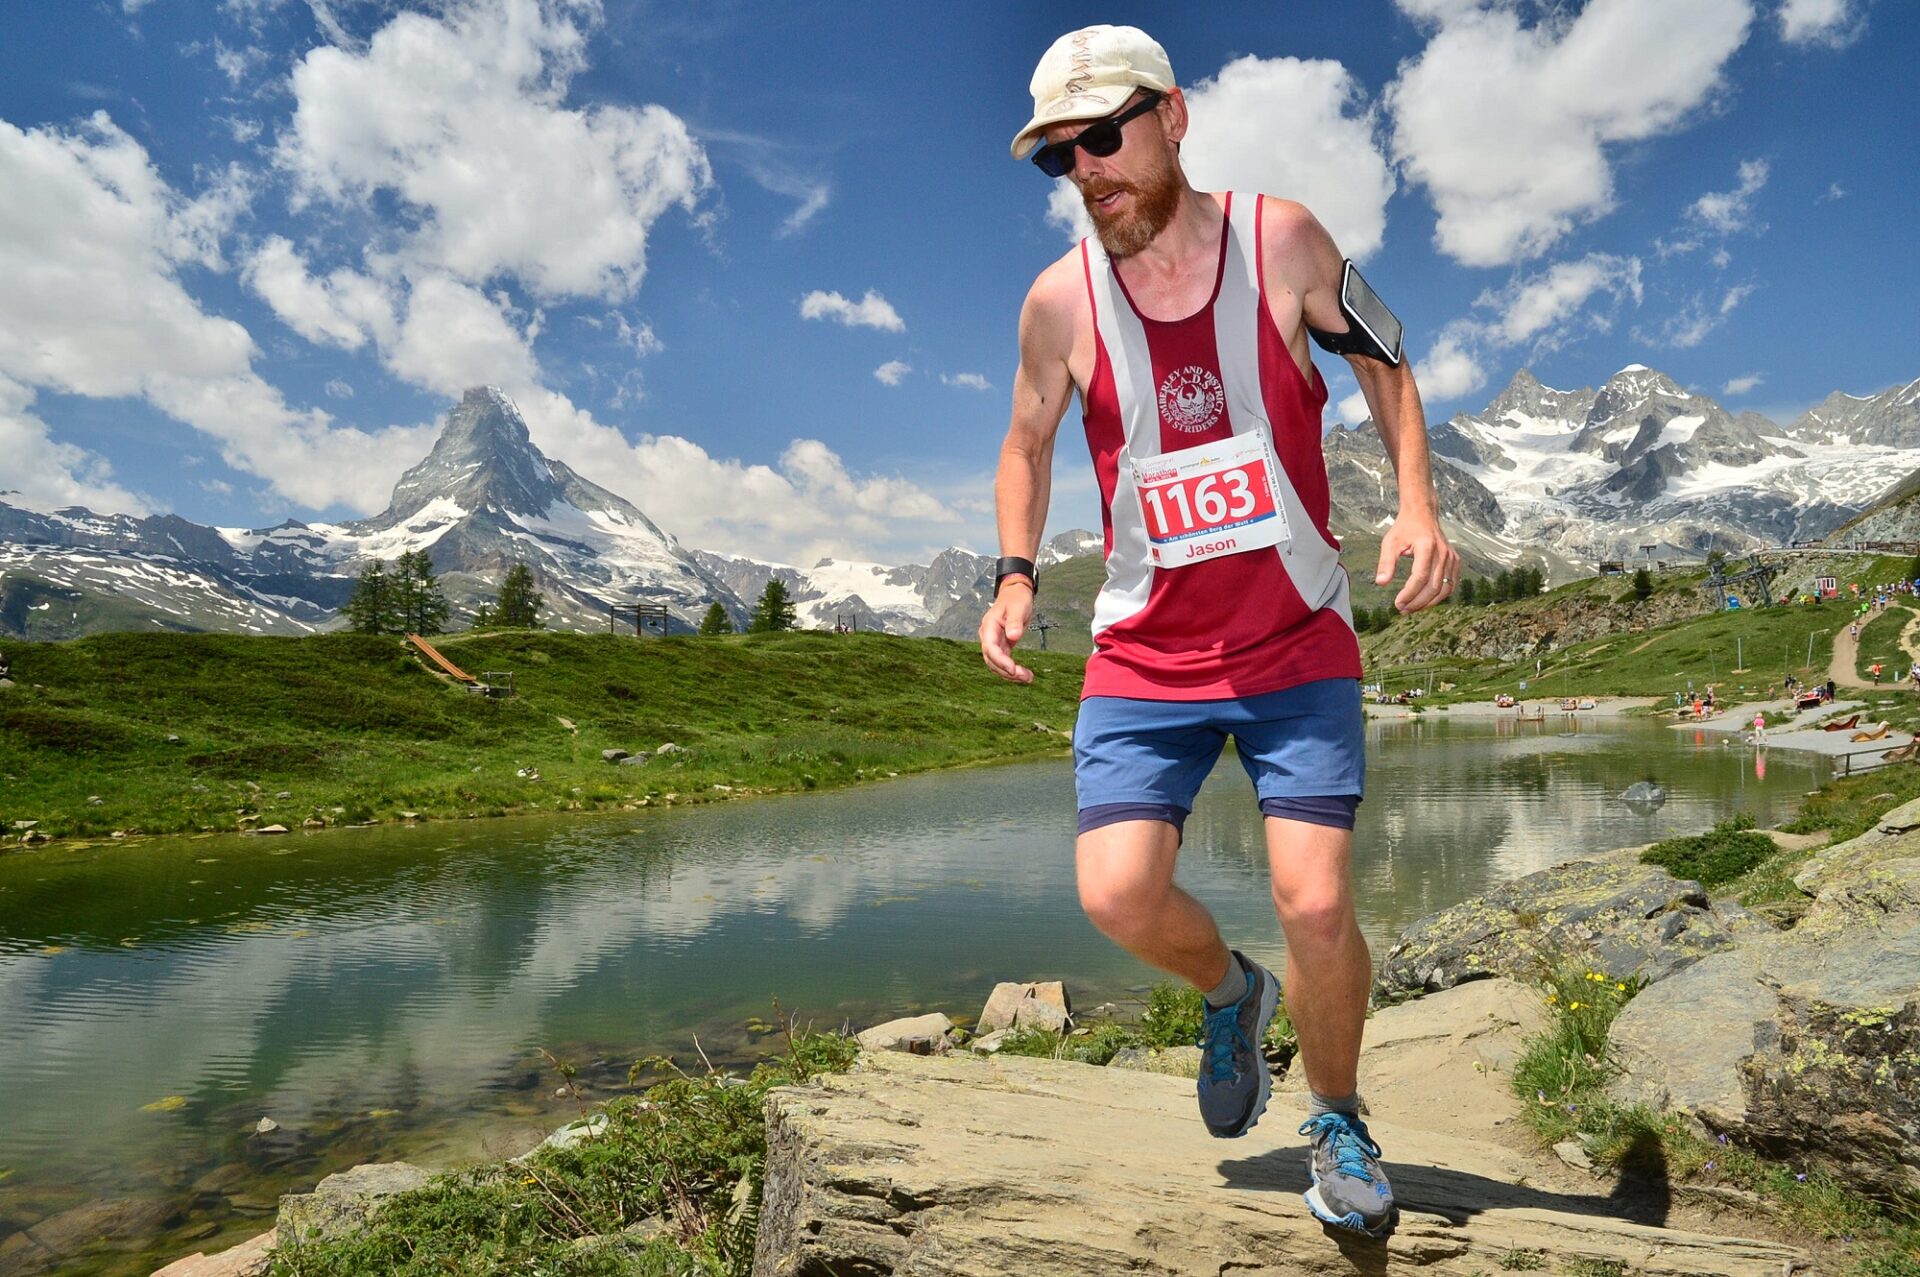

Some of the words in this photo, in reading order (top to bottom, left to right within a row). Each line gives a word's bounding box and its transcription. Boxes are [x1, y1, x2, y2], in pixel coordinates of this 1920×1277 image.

[1183, 365, 1203, 375] AND
[1204, 371, 1224, 415] DISTRICT
[1172, 414, 1218, 433] STRIDERS
[1145, 469, 1256, 535] 1163
[1186, 538, 1237, 558] Jason
